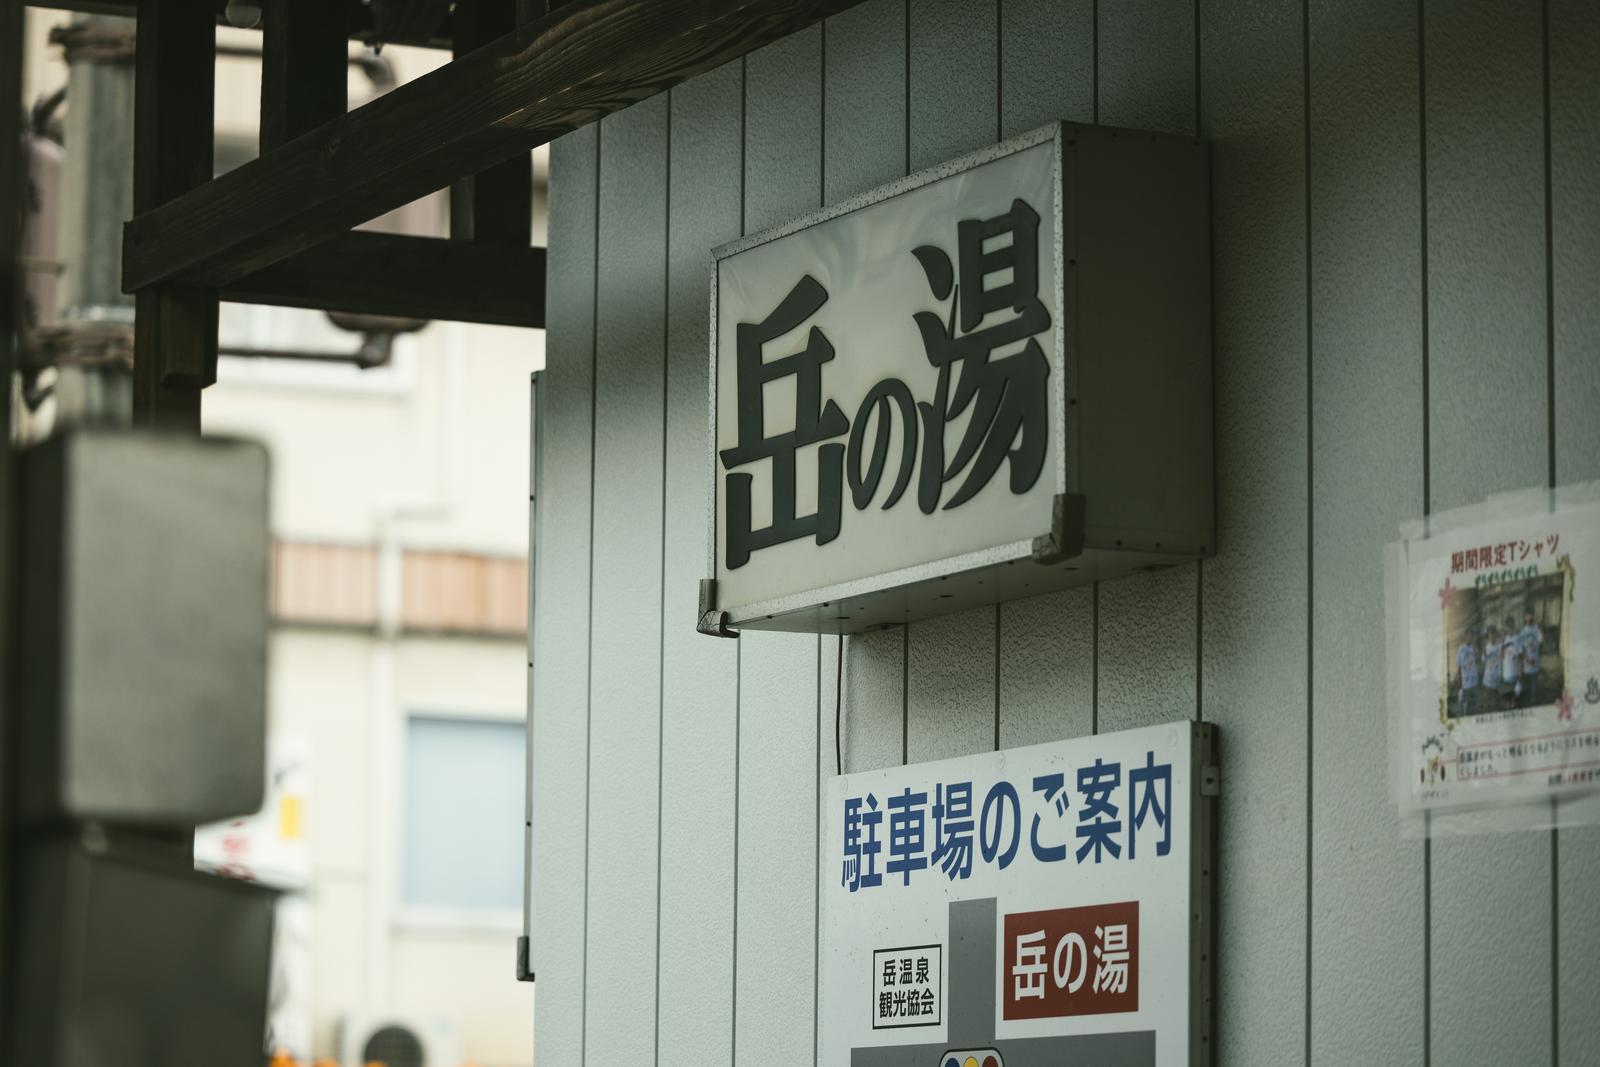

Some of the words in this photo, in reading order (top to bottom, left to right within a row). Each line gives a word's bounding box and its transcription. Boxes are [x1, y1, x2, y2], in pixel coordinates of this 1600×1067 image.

[719, 198, 1051, 570] 岳の湯
[1450, 533, 1560, 574] 期間限定Tシャツ
[841, 751, 1172, 892] 駐車場のご案内
[883, 956, 929, 987] 岳温泉
[1012, 924, 1130, 1001] 岳の湯
[879, 988, 934, 1018] 観光協会
